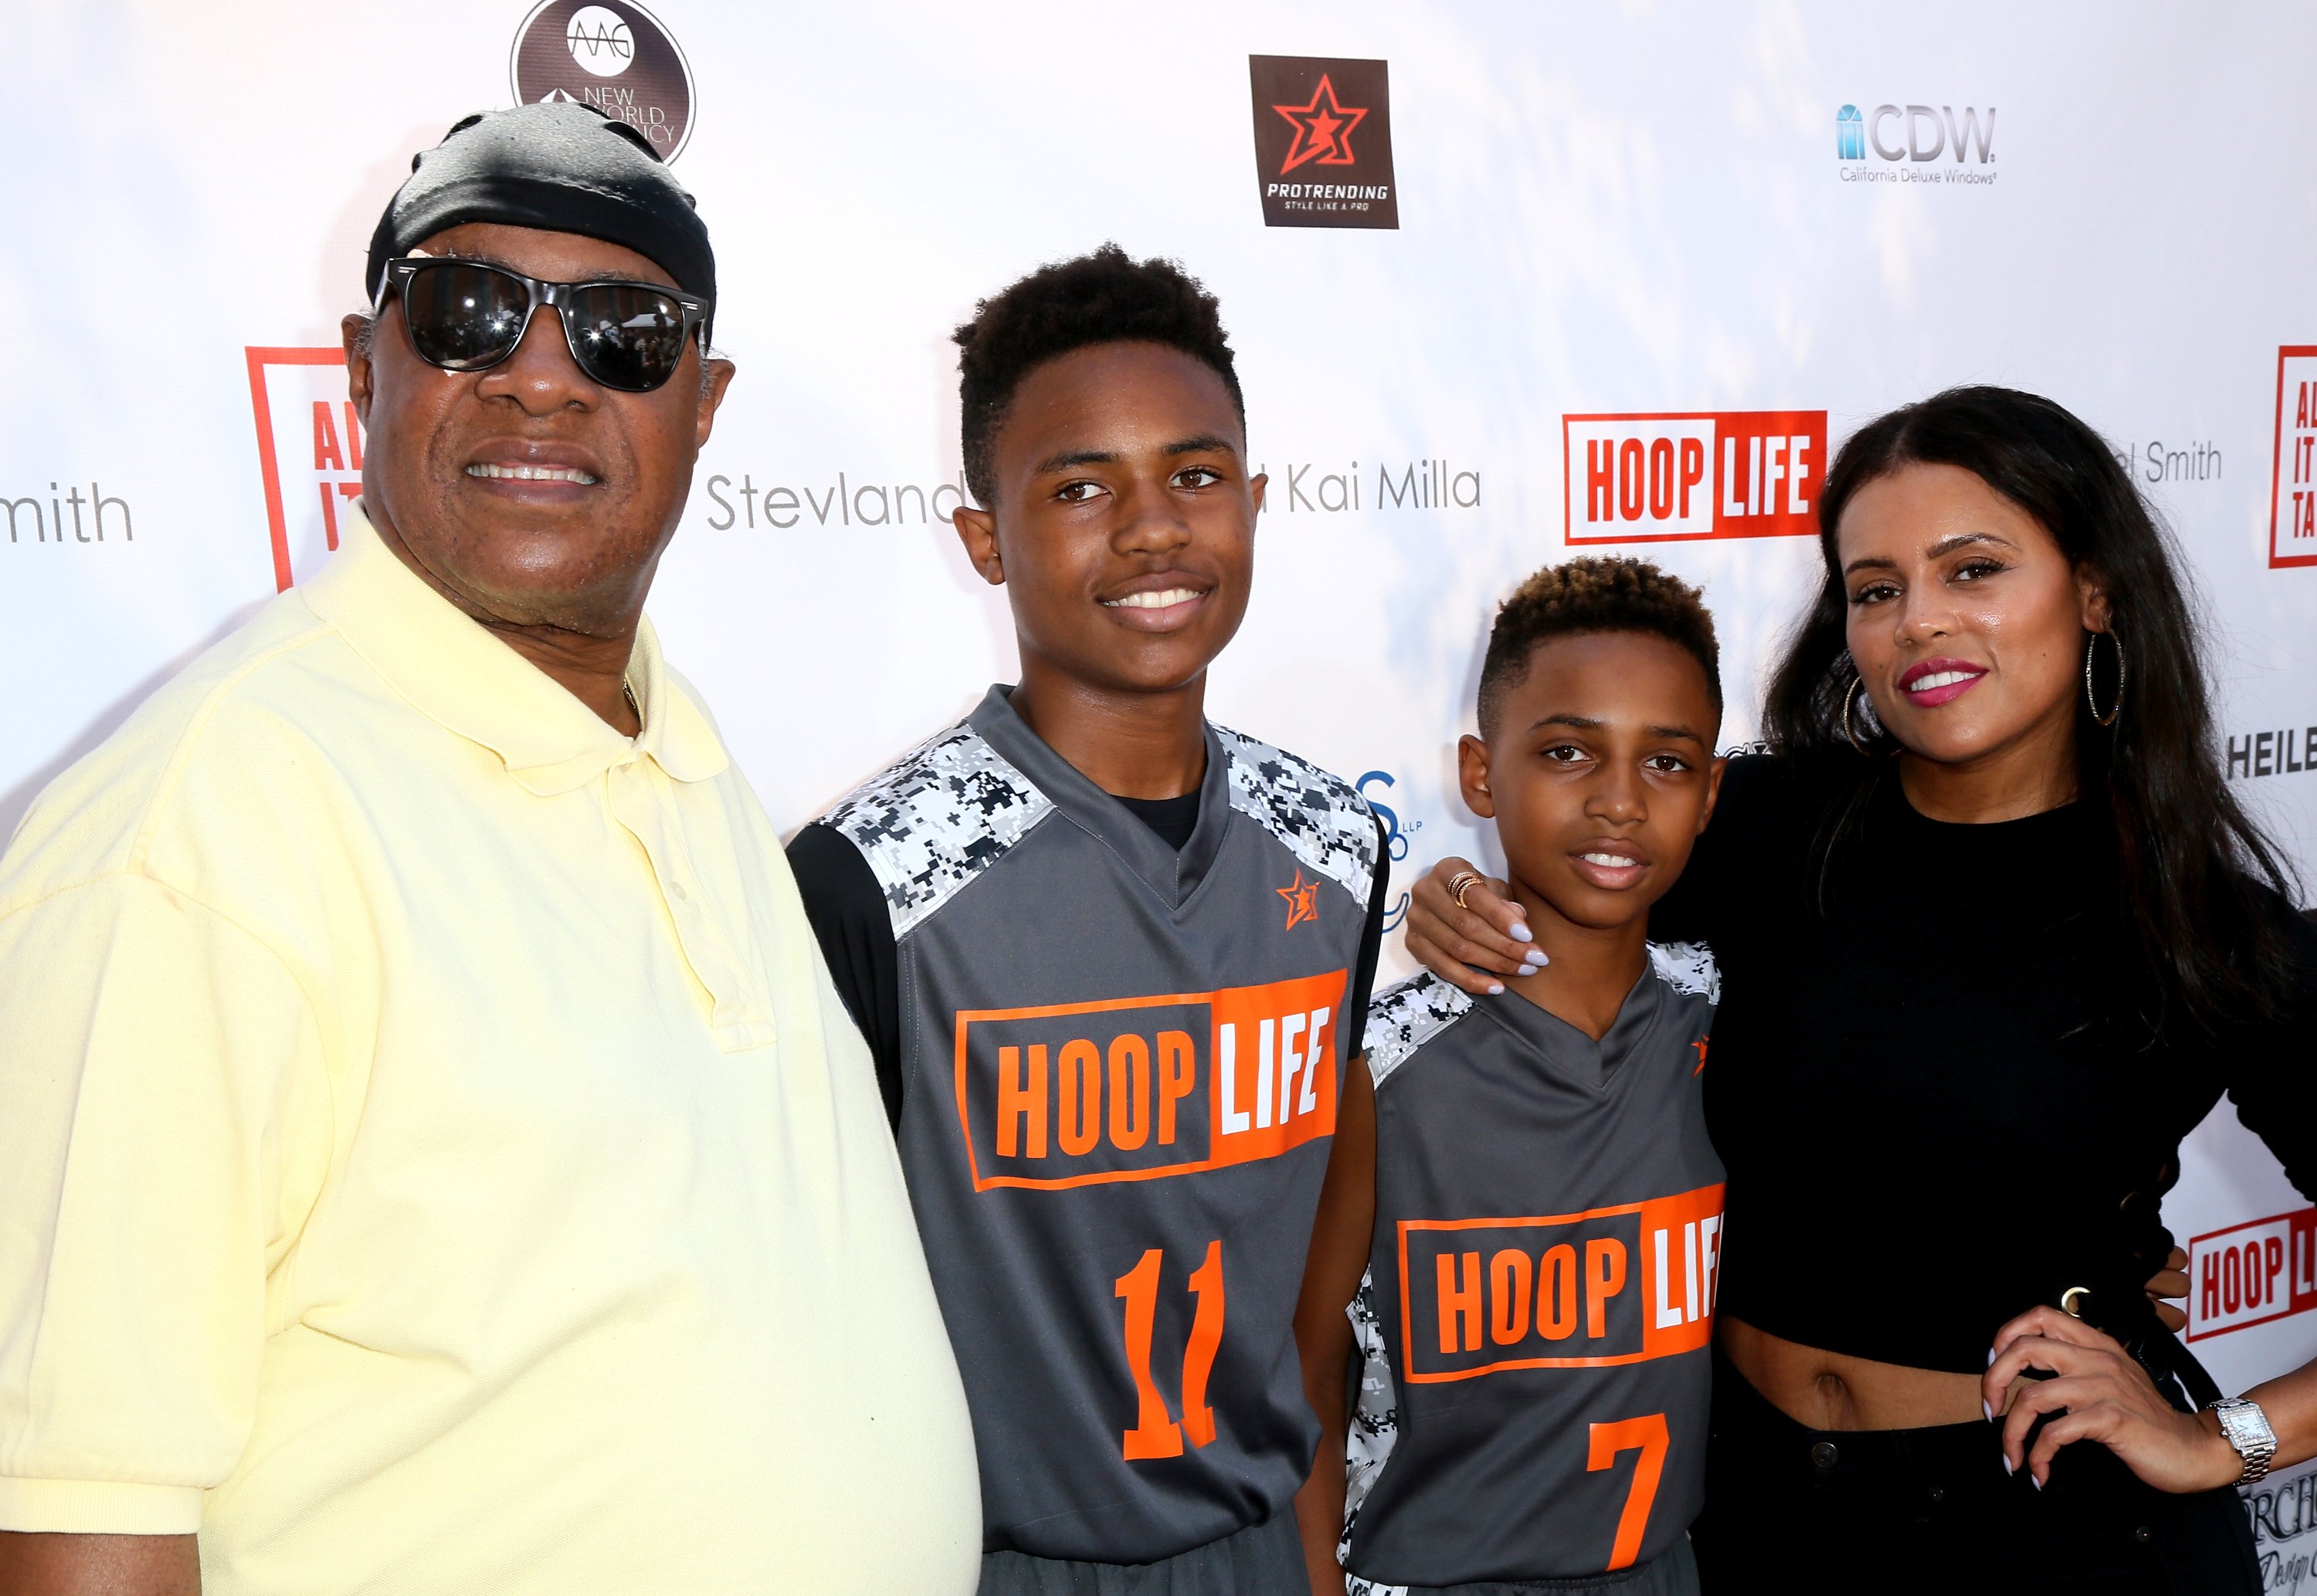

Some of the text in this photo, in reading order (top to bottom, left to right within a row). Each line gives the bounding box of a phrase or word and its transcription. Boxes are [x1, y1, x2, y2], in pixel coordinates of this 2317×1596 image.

[585, 86, 633, 105] NEW
[1267, 183, 1389, 200] PROTRENDING
[1840, 167, 1897, 183] California
[1901, 168, 1941, 183] Deluxe
[1284, 202, 1313, 211] STYLE
[1317, 202, 1338, 211] LIKE
[1351, 203, 1369, 212] PRO
[1587, 435, 1810, 522] HOOP LIFE
[2146, 440, 2221, 483] Smith
[2294, 436, 2315, 483] IT
[707, 469, 966, 531] Stevland
[1287, 461, 1359, 512] Kai
[1378, 459, 1481, 509] Milla
[1403, 821, 1423, 833] LLP
[996, 1006, 1331, 1159] HOOP LIFE
[1437, 1211, 1725, 1354] HOOP LIF
[2202, 1236, 2283, 1321] HOOP
[1114, 1240, 1225, 1461] 11
[1586, 1412, 1670, 1572] 7
